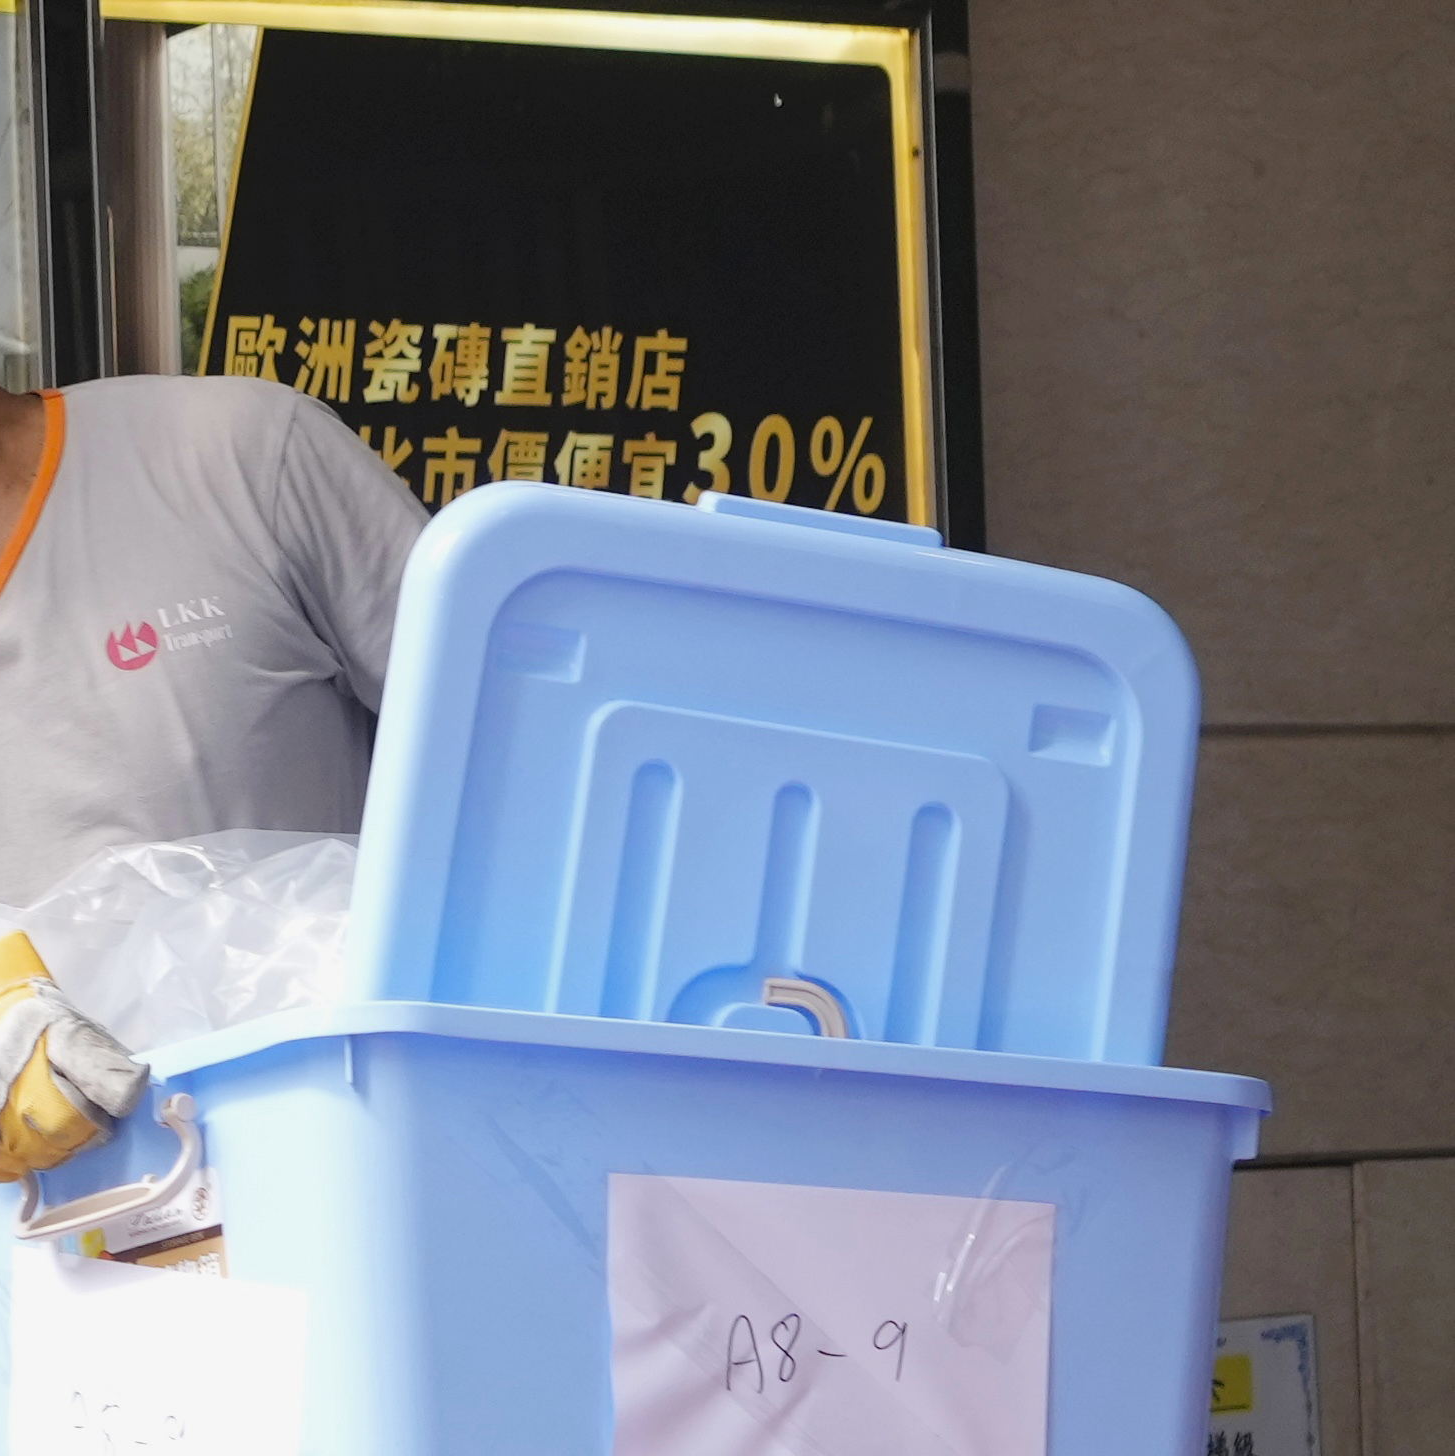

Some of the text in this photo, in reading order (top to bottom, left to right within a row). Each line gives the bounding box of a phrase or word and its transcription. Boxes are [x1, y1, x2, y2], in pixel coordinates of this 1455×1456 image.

[225, 313, 689, 411] 歐洲瓷磚直銷店
